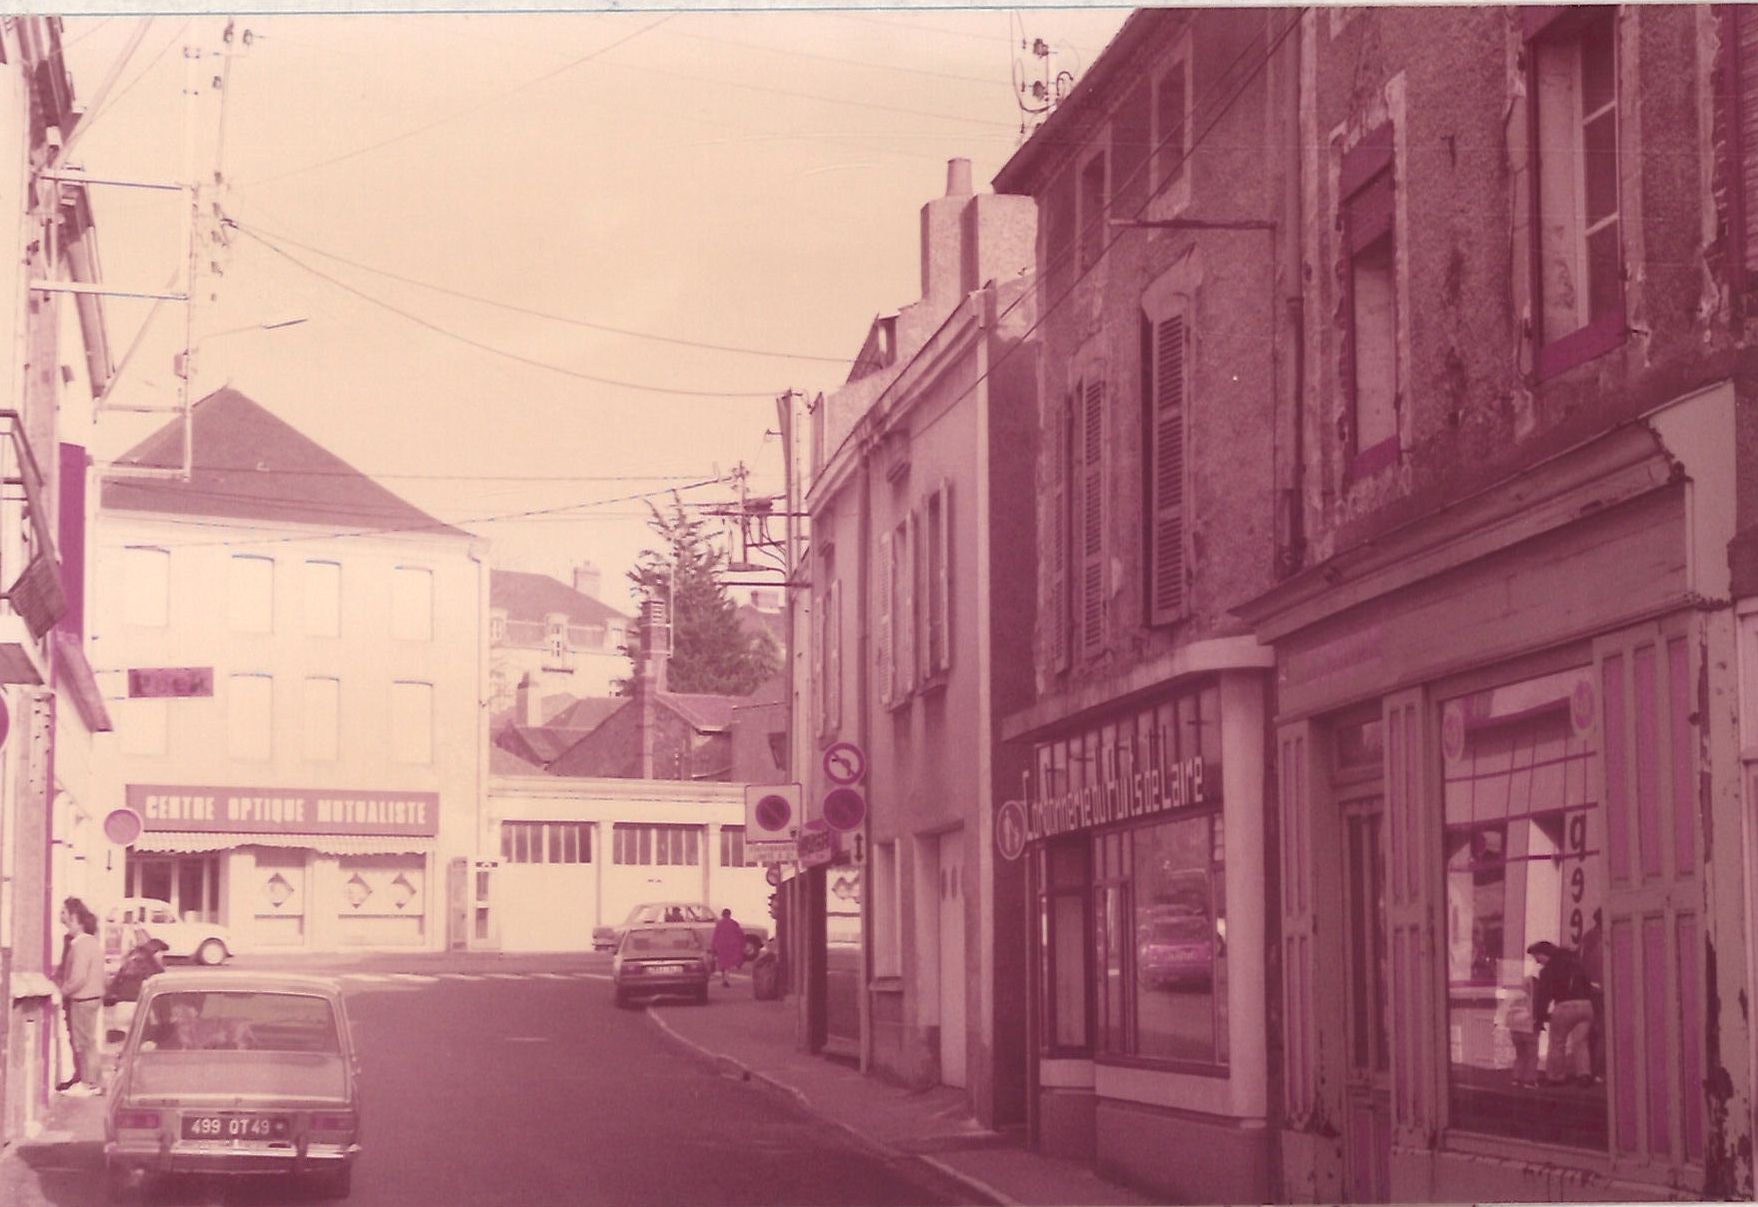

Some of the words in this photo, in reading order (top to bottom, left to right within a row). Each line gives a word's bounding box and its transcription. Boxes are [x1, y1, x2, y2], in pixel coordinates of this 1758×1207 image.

[145, 795, 214, 820] CENTRE
[227, 797, 304, 823] OPTIQUE
[317, 800, 426, 824] MUTUALISTE
[191, 1119, 220, 1134] 499
[251, 1120, 269, 1134] 49
